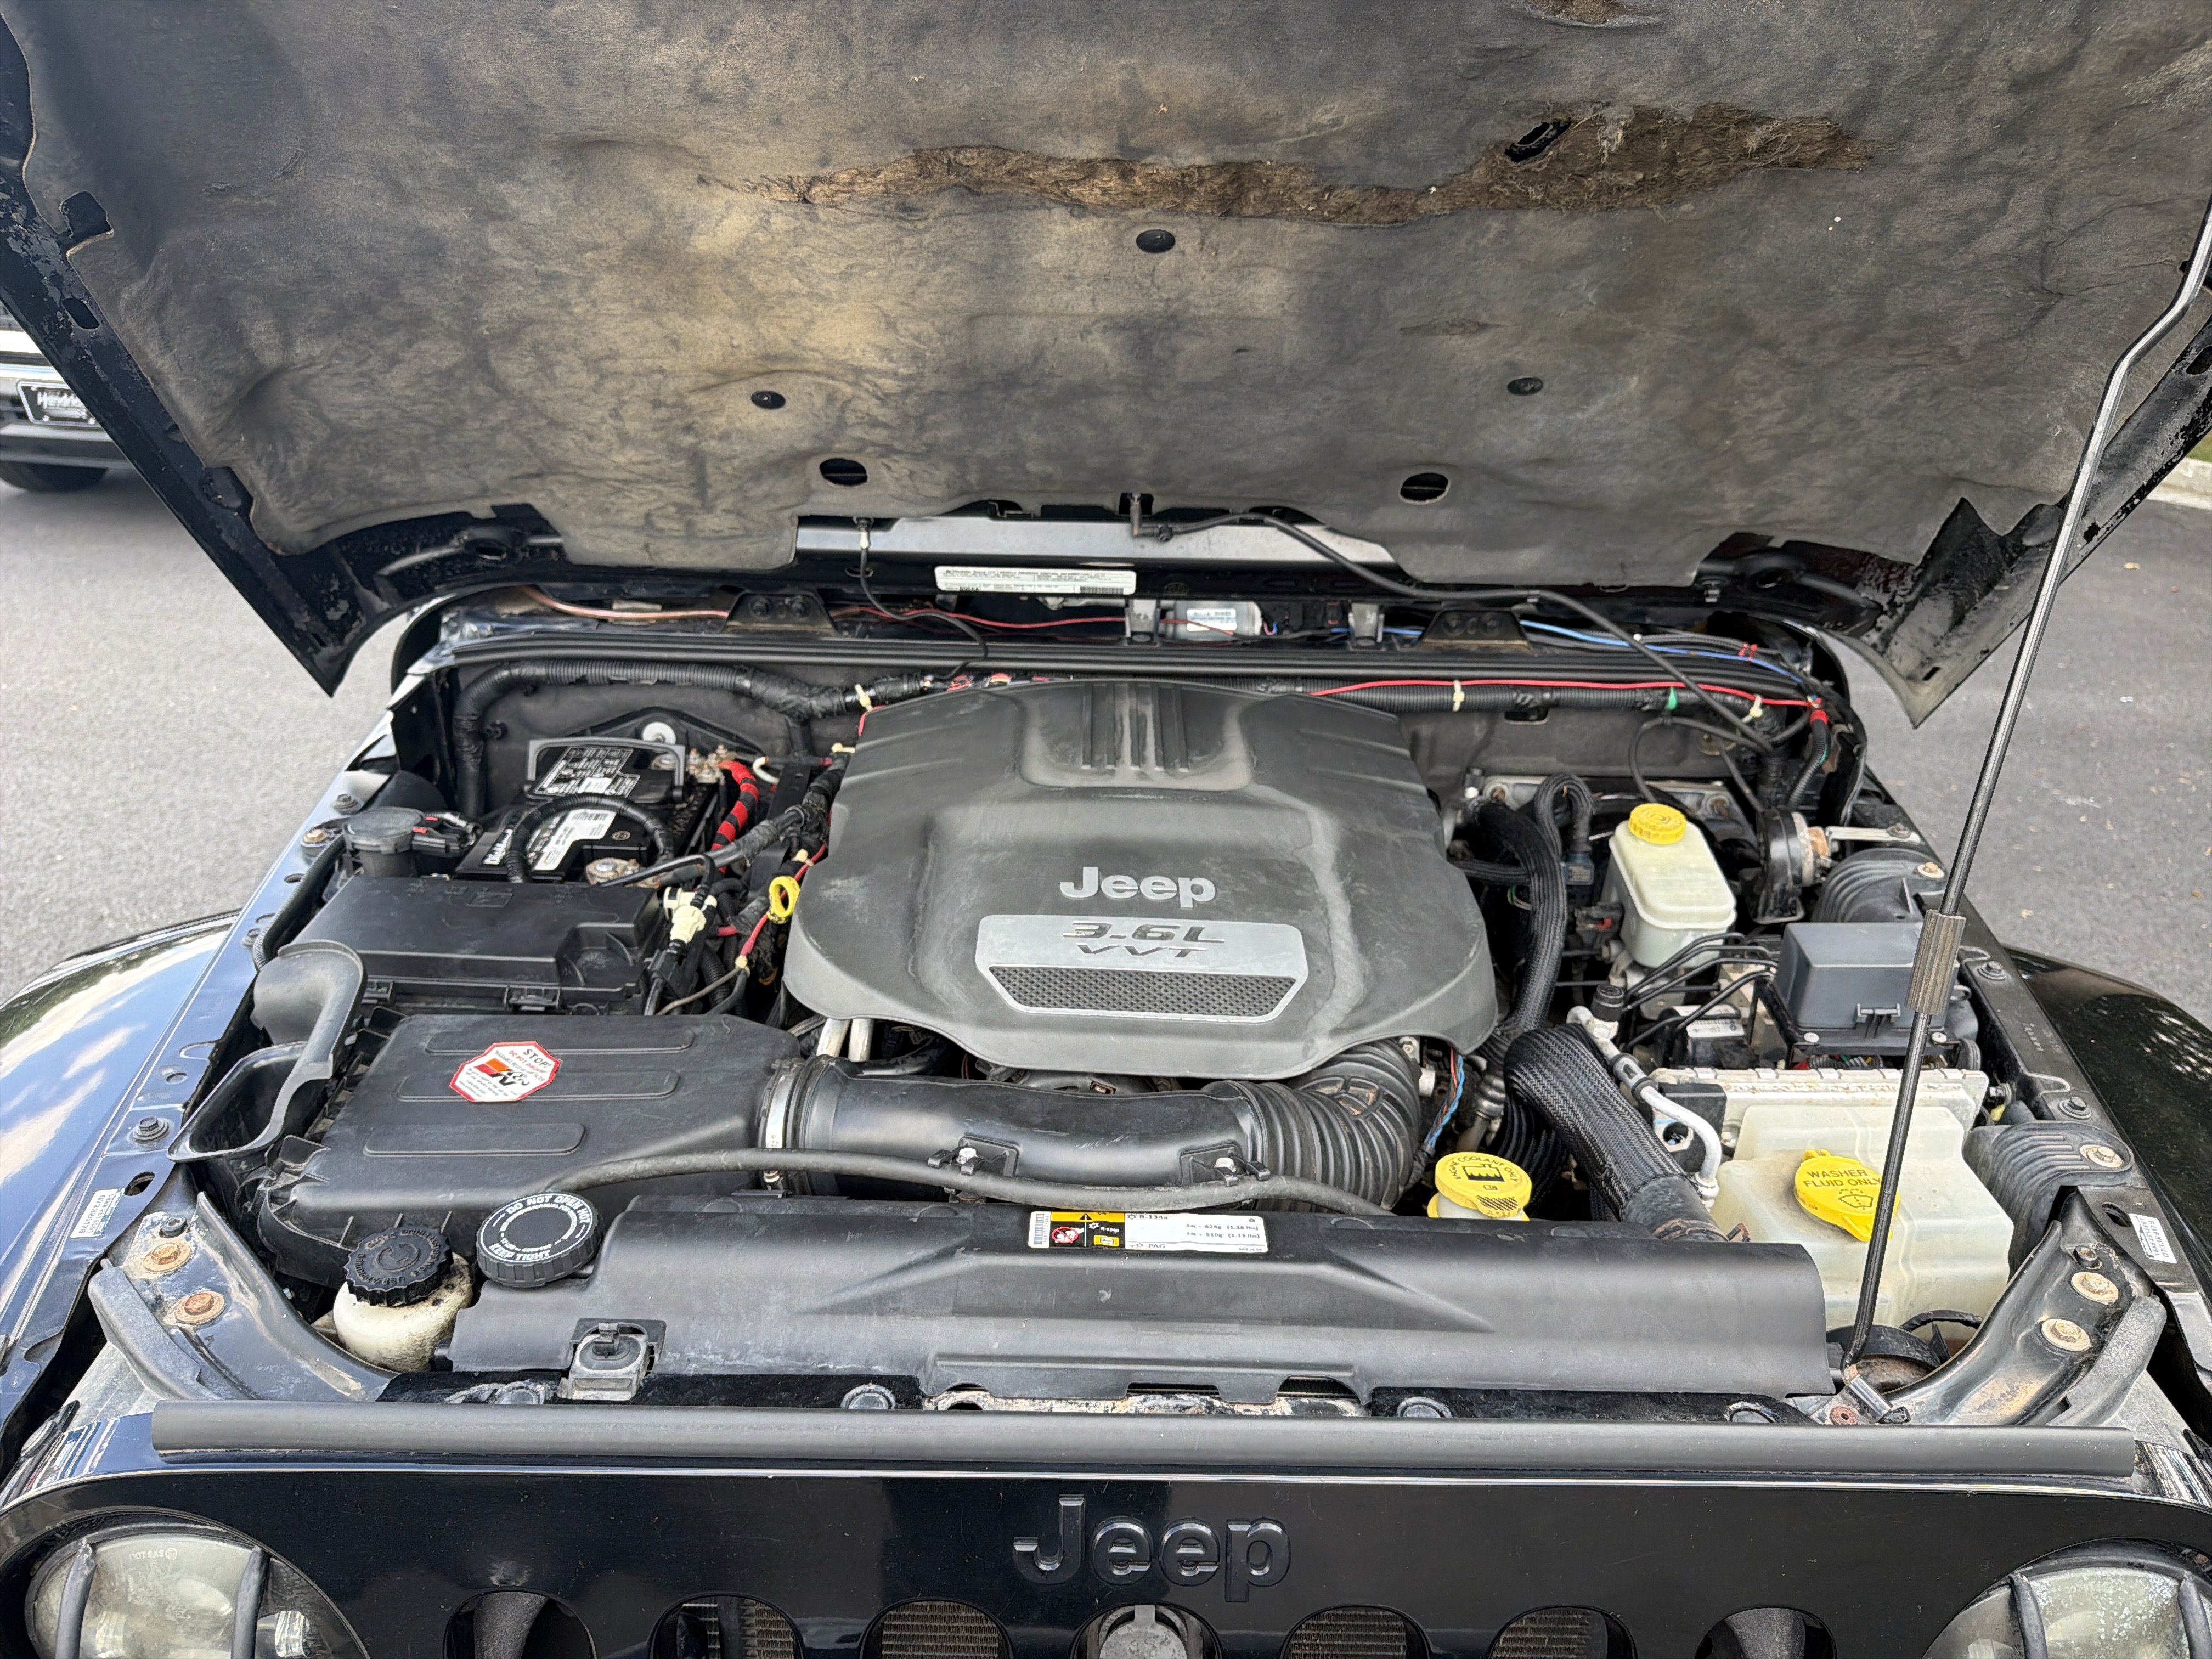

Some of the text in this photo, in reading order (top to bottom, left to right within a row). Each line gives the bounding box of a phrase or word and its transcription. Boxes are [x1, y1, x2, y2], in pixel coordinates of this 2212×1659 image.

[1060, 866, 1216, 909] Jeep
[1062, 922, 1225, 943] 3.6L
[1076, 944, 1207, 958] VVT
[523, 1048, 552, 1068] STOP!
[1449, 1156, 1519, 1182] ENGINE COOLANT ONLY
[1806, 1169, 1868, 1178] WASHER
[1847, 1177, 1880, 1186] ONLY
[506, 1195, 590, 1223] DO NOT OPEN HOT
[489, 1243, 515, 1259] KEEP
[515, 1250, 550, 1261] TIGHT
[1012, 1493, 1291, 1603] Jeep
